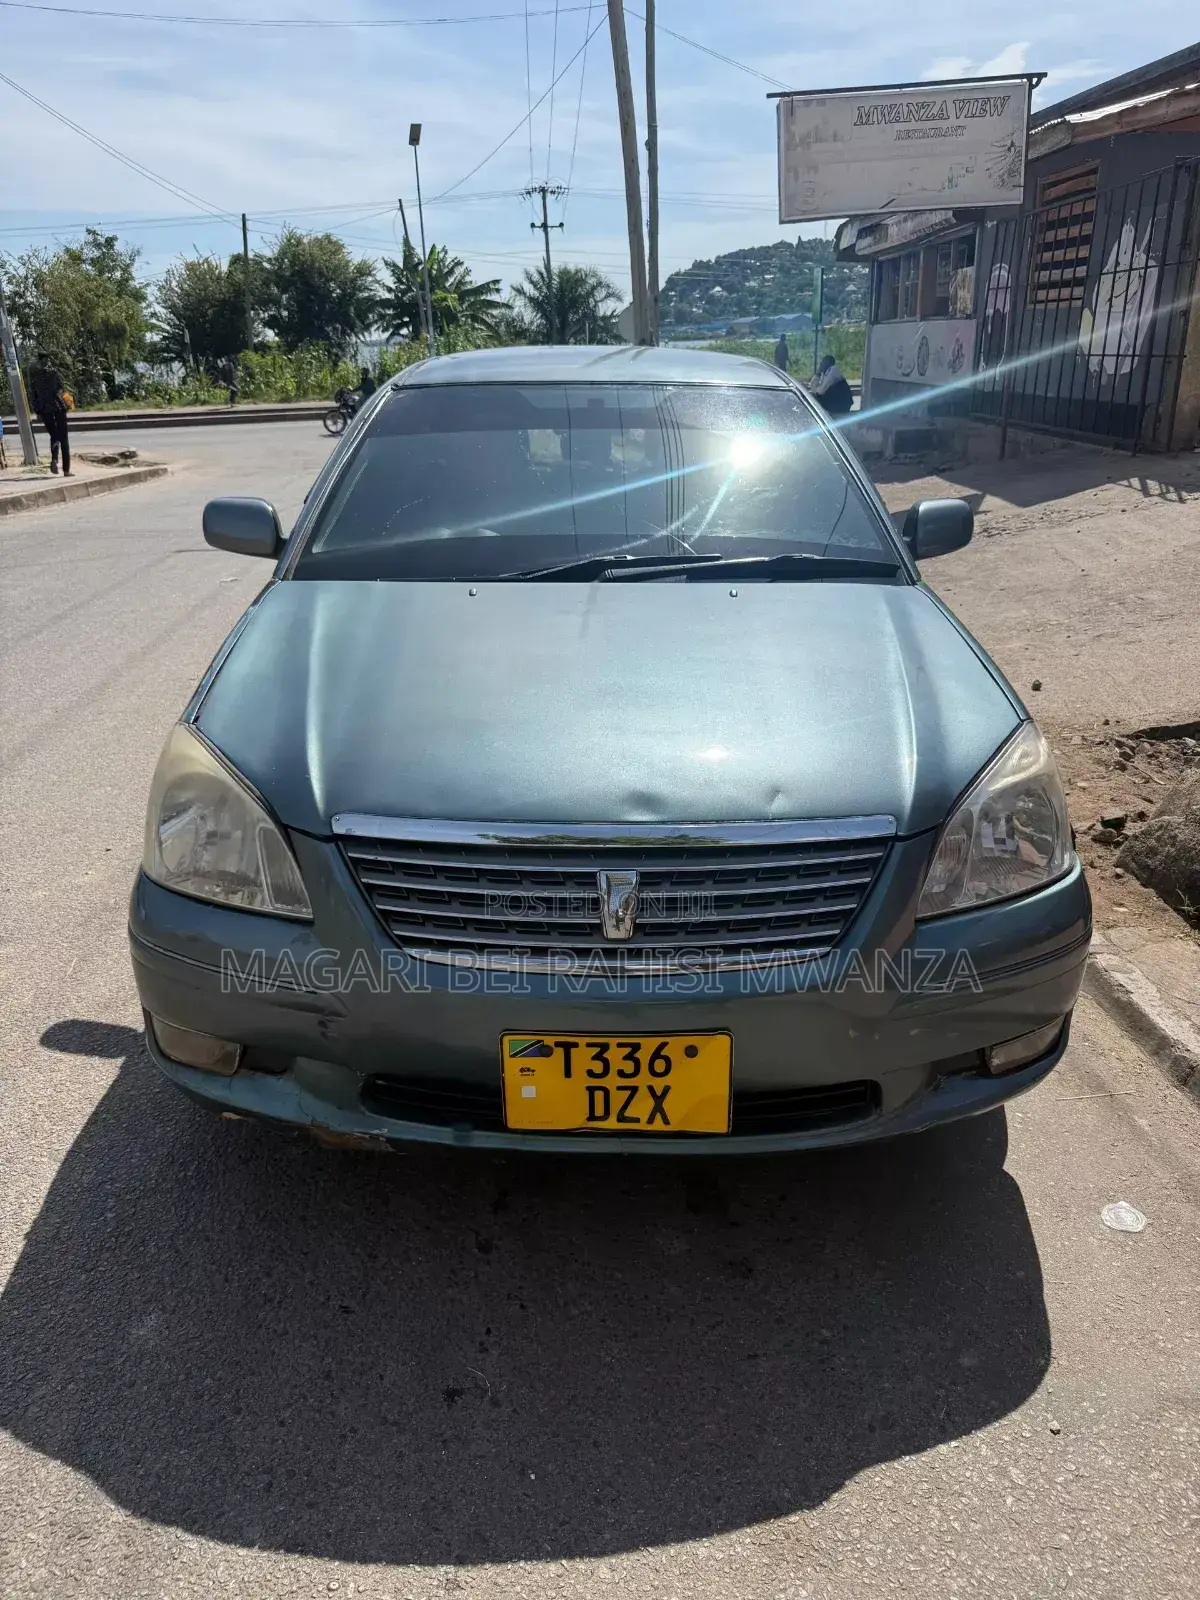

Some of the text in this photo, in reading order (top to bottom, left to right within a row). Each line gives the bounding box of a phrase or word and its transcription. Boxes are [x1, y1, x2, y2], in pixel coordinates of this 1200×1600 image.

[854, 95, 1011, 126] MWANZA VIEW
[894, 125, 967, 141] RESTAURANT
[554, 1041, 673, 1079] T336
[585, 1084, 672, 1125] DZX
